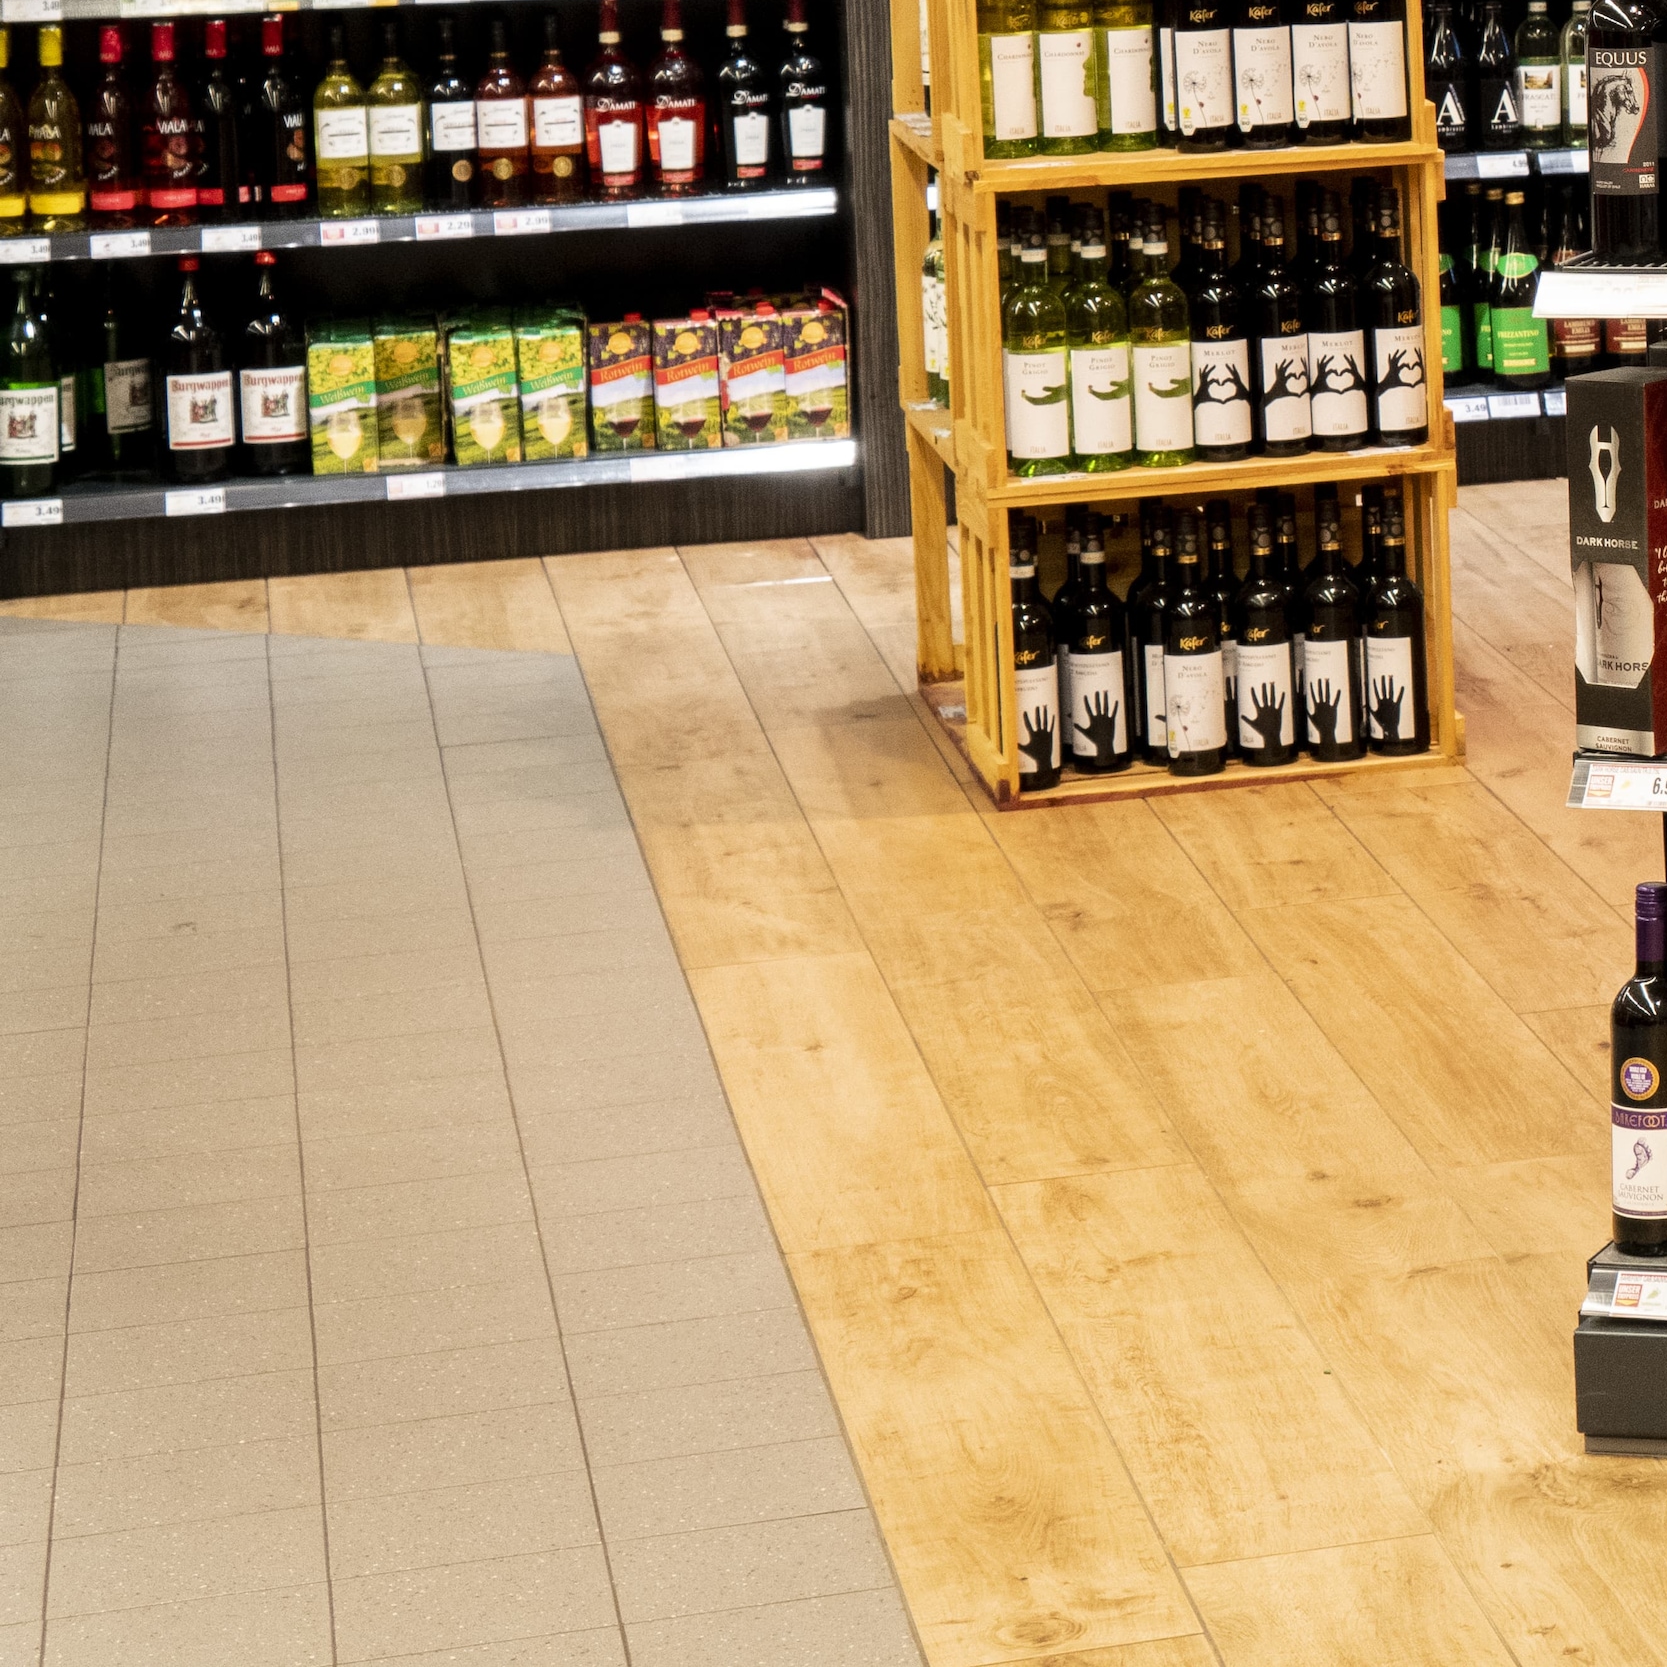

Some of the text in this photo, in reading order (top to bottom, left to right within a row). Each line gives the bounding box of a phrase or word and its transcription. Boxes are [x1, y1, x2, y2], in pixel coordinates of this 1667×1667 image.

[1190, 10, 1216, 23] Käfer
[1249, 6, 1276, 20] Käfer
[1307, 3, 1335, 17] Käfer
[1595, 52, 1646, 65] EQUUS
[1577, 536, 1638, 549] DARK HORSE
